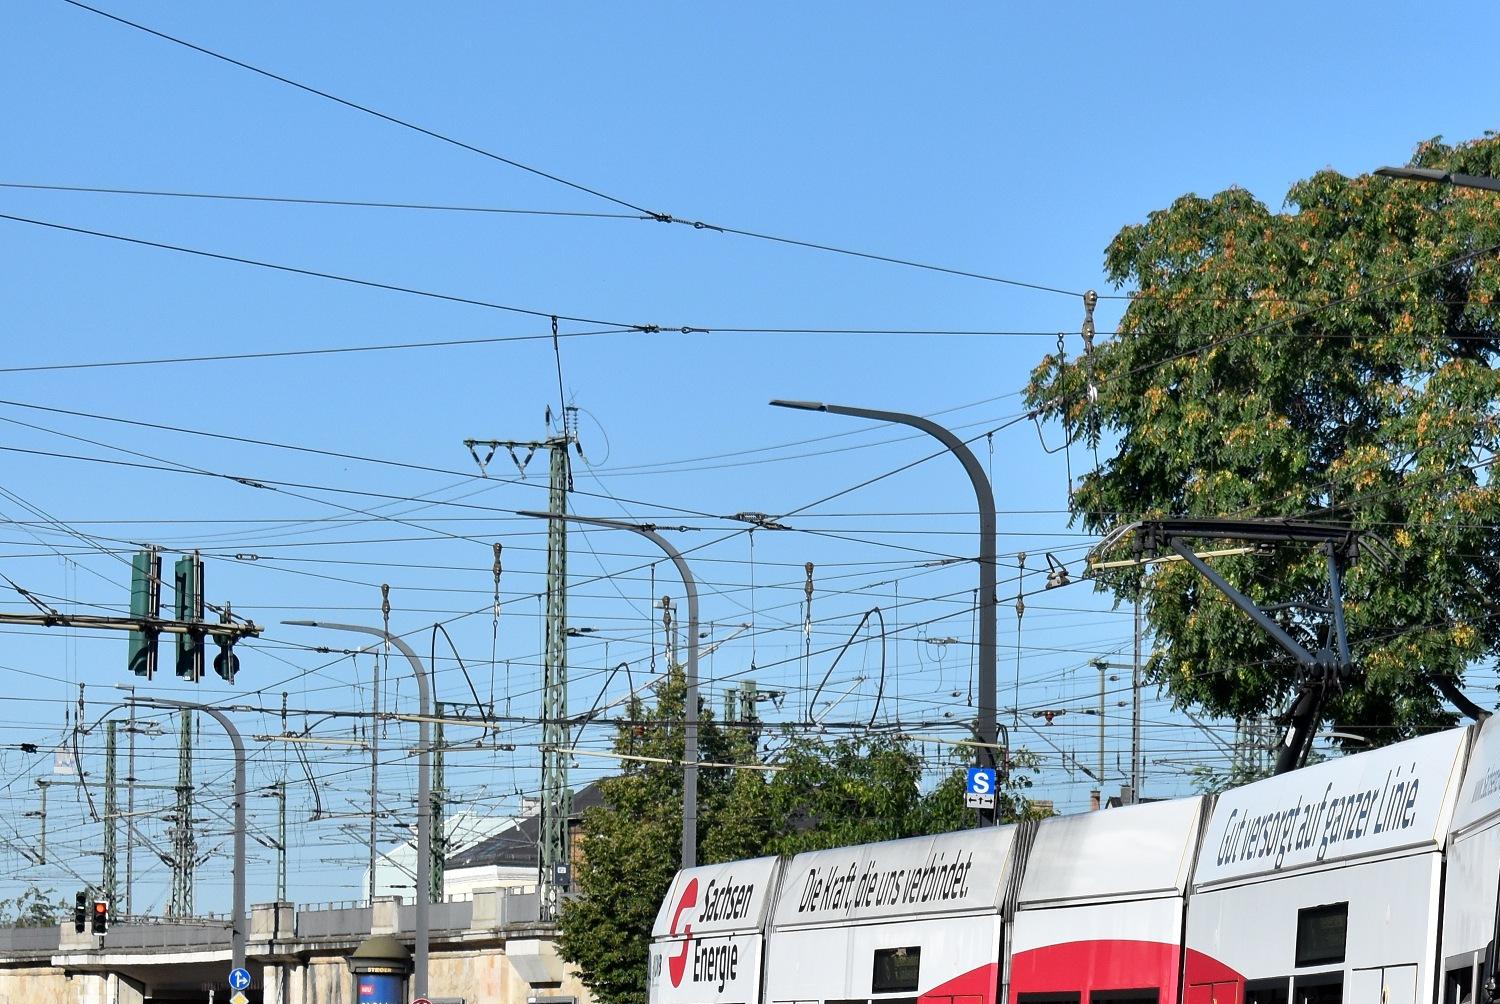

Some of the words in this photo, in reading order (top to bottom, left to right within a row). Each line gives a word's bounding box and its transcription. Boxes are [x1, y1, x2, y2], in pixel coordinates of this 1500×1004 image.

[973, 772, 989, 794] S
[1217, 808, 1248, 867] Gut
[1240, 795, 1303, 869] versorgt
[1295, 782, 1333, 851] auf
[1316, 787, 1380, 861] ganzer
[1373, 762, 1420, 835] Linie.
[698, 875, 754, 923] Sachsen
[798, 866, 823, 913] Die
[820, 861, 857, 916] Kraft,
[854, 860, 878, 908] die
[875, 869, 905, 906] uns
[902, 849, 973, 904] verbindet.
[693, 933, 738, 993] Energie
